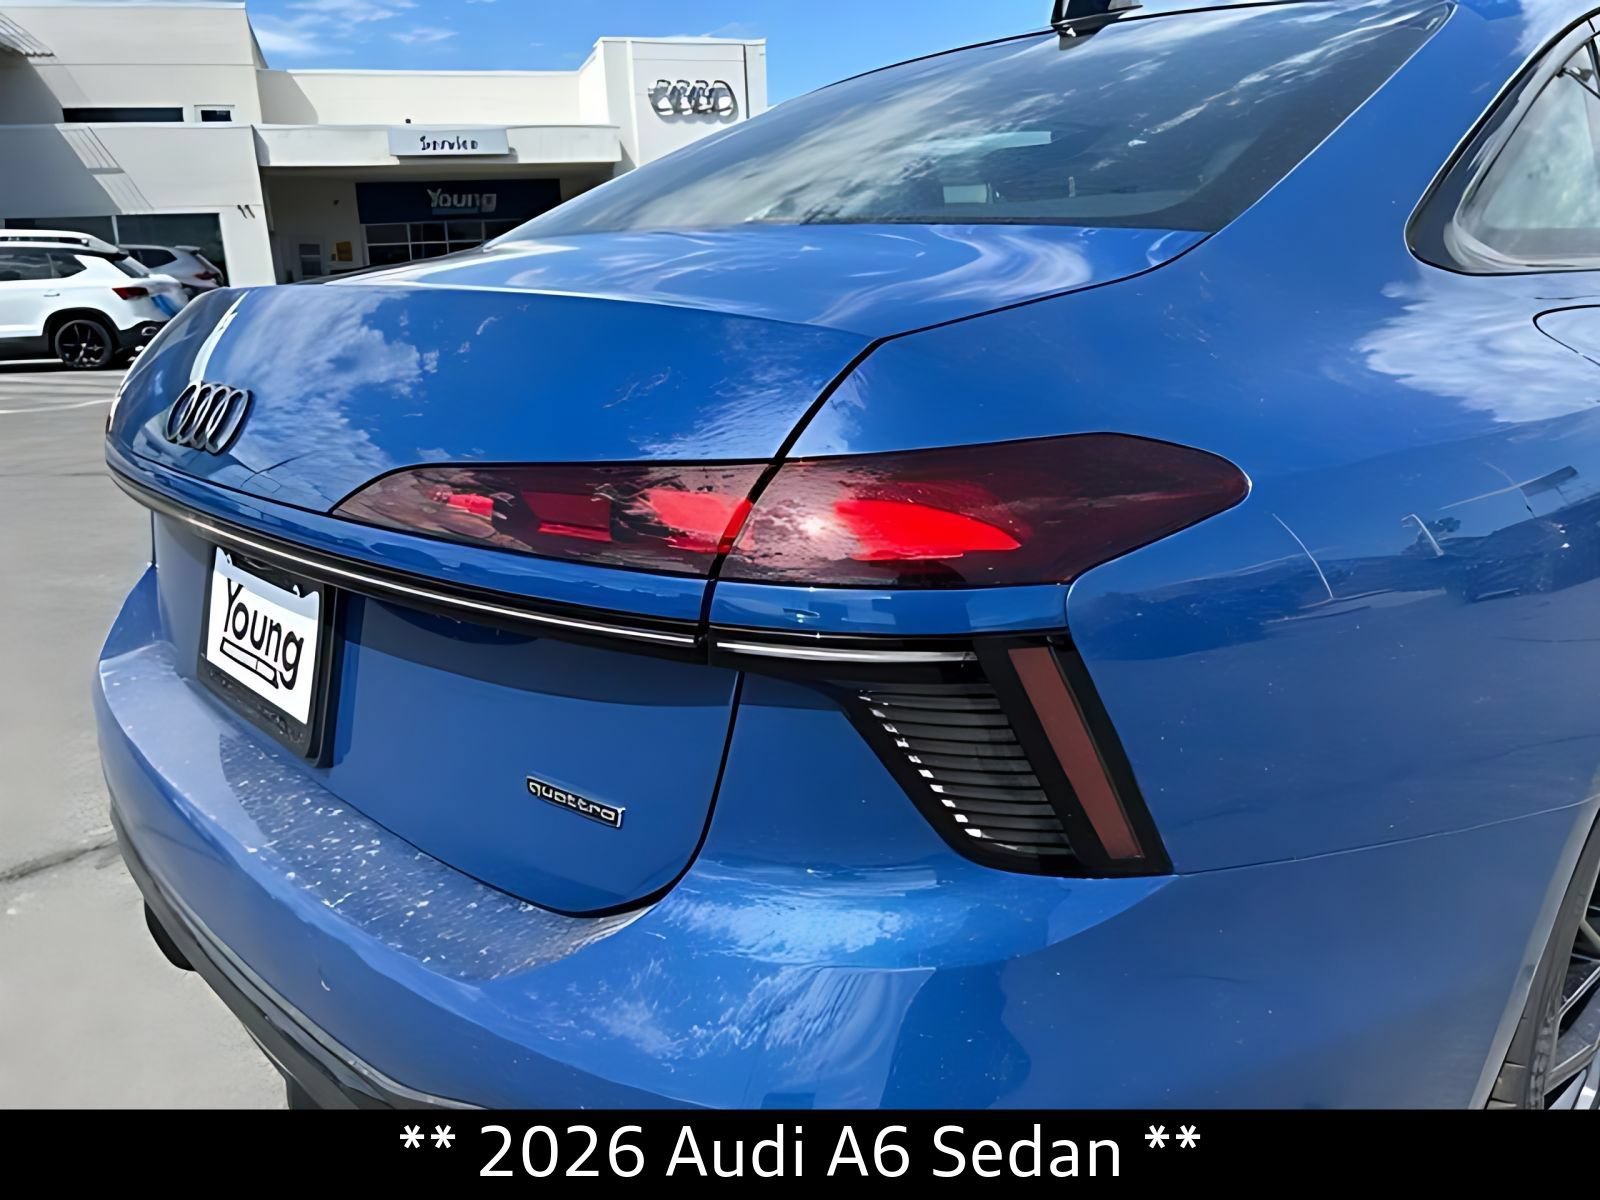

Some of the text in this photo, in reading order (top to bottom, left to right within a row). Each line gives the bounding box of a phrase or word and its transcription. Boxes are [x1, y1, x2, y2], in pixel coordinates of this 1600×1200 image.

[426, 188, 497, 213] Young
[223, 577, 305, 691] Young
[528, 781, 616, 821] quattro
